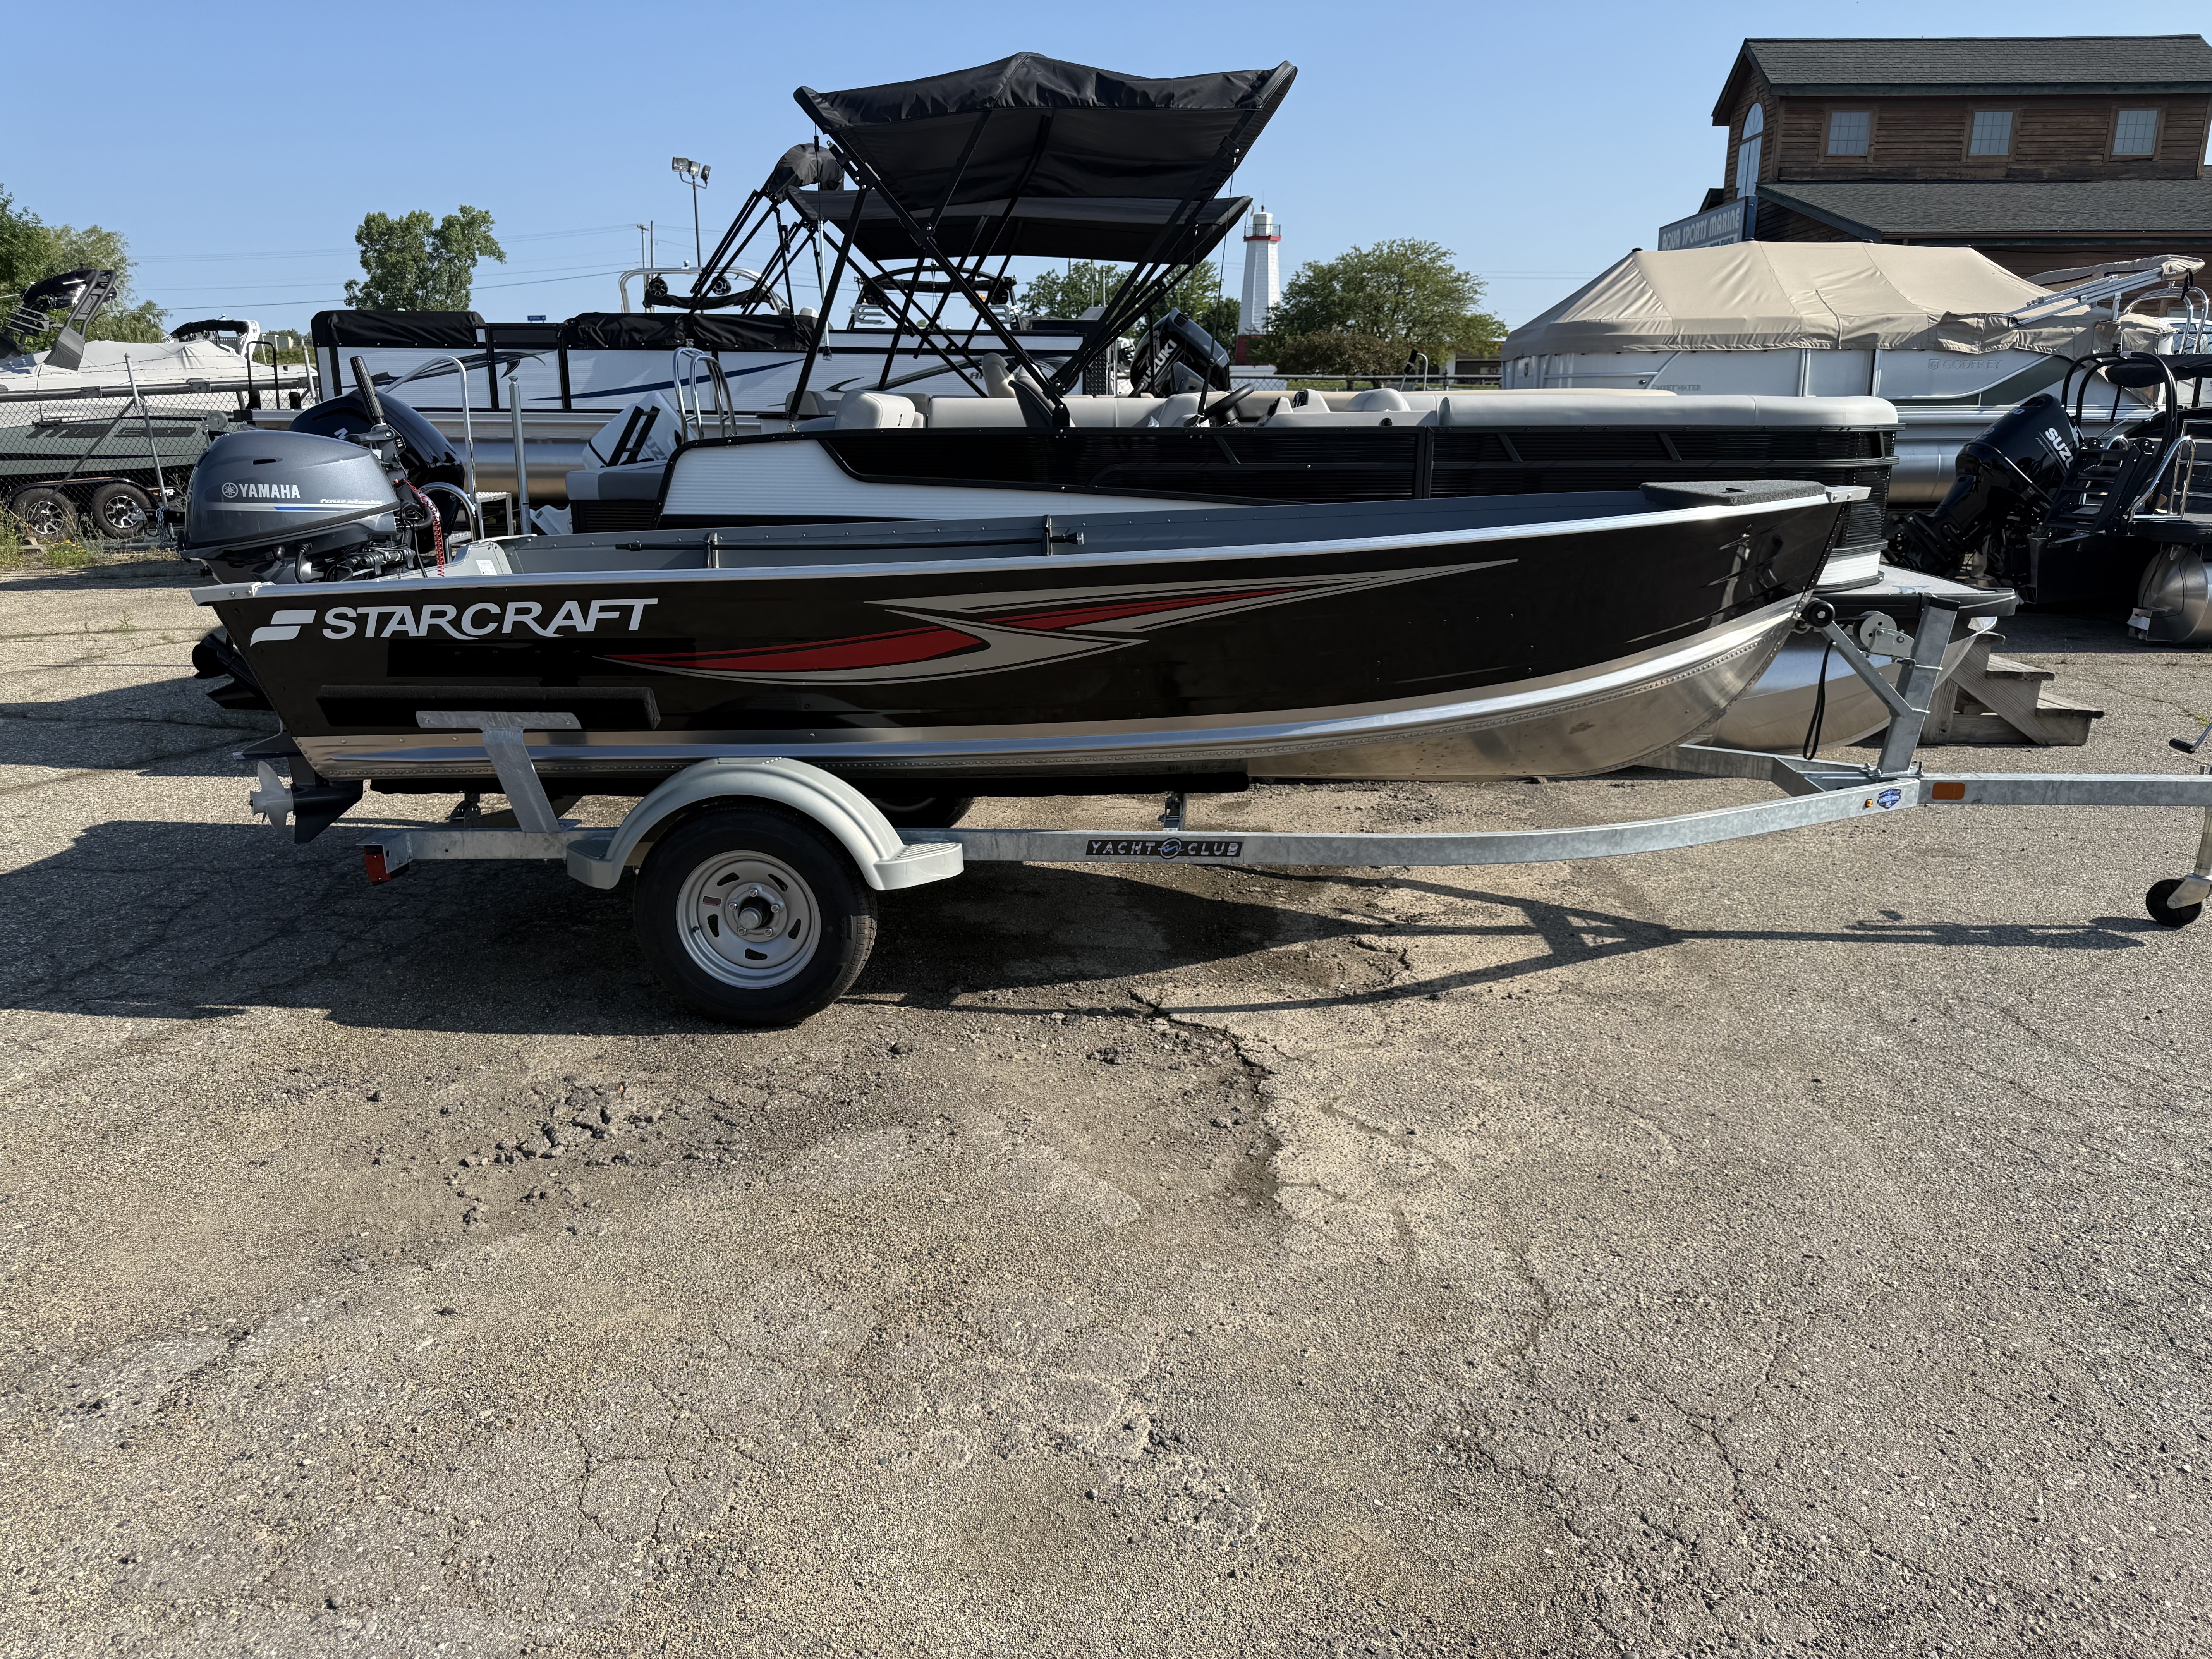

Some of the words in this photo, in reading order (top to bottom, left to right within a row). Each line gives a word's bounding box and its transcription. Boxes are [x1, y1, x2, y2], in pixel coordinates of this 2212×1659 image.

[1682, 219, 1707, 246] SPORTS
[1709, 208, 1740, 237] MARINE
[1943, 360, 2002, 371] GODFREY
[239, 483, 301, 499] YAMAHA
[322, 598, 658, 640] STARCRAFT
[1091, 841, 1156, 854] YACHT
[1187, 842, 1238, 855] CLUB
